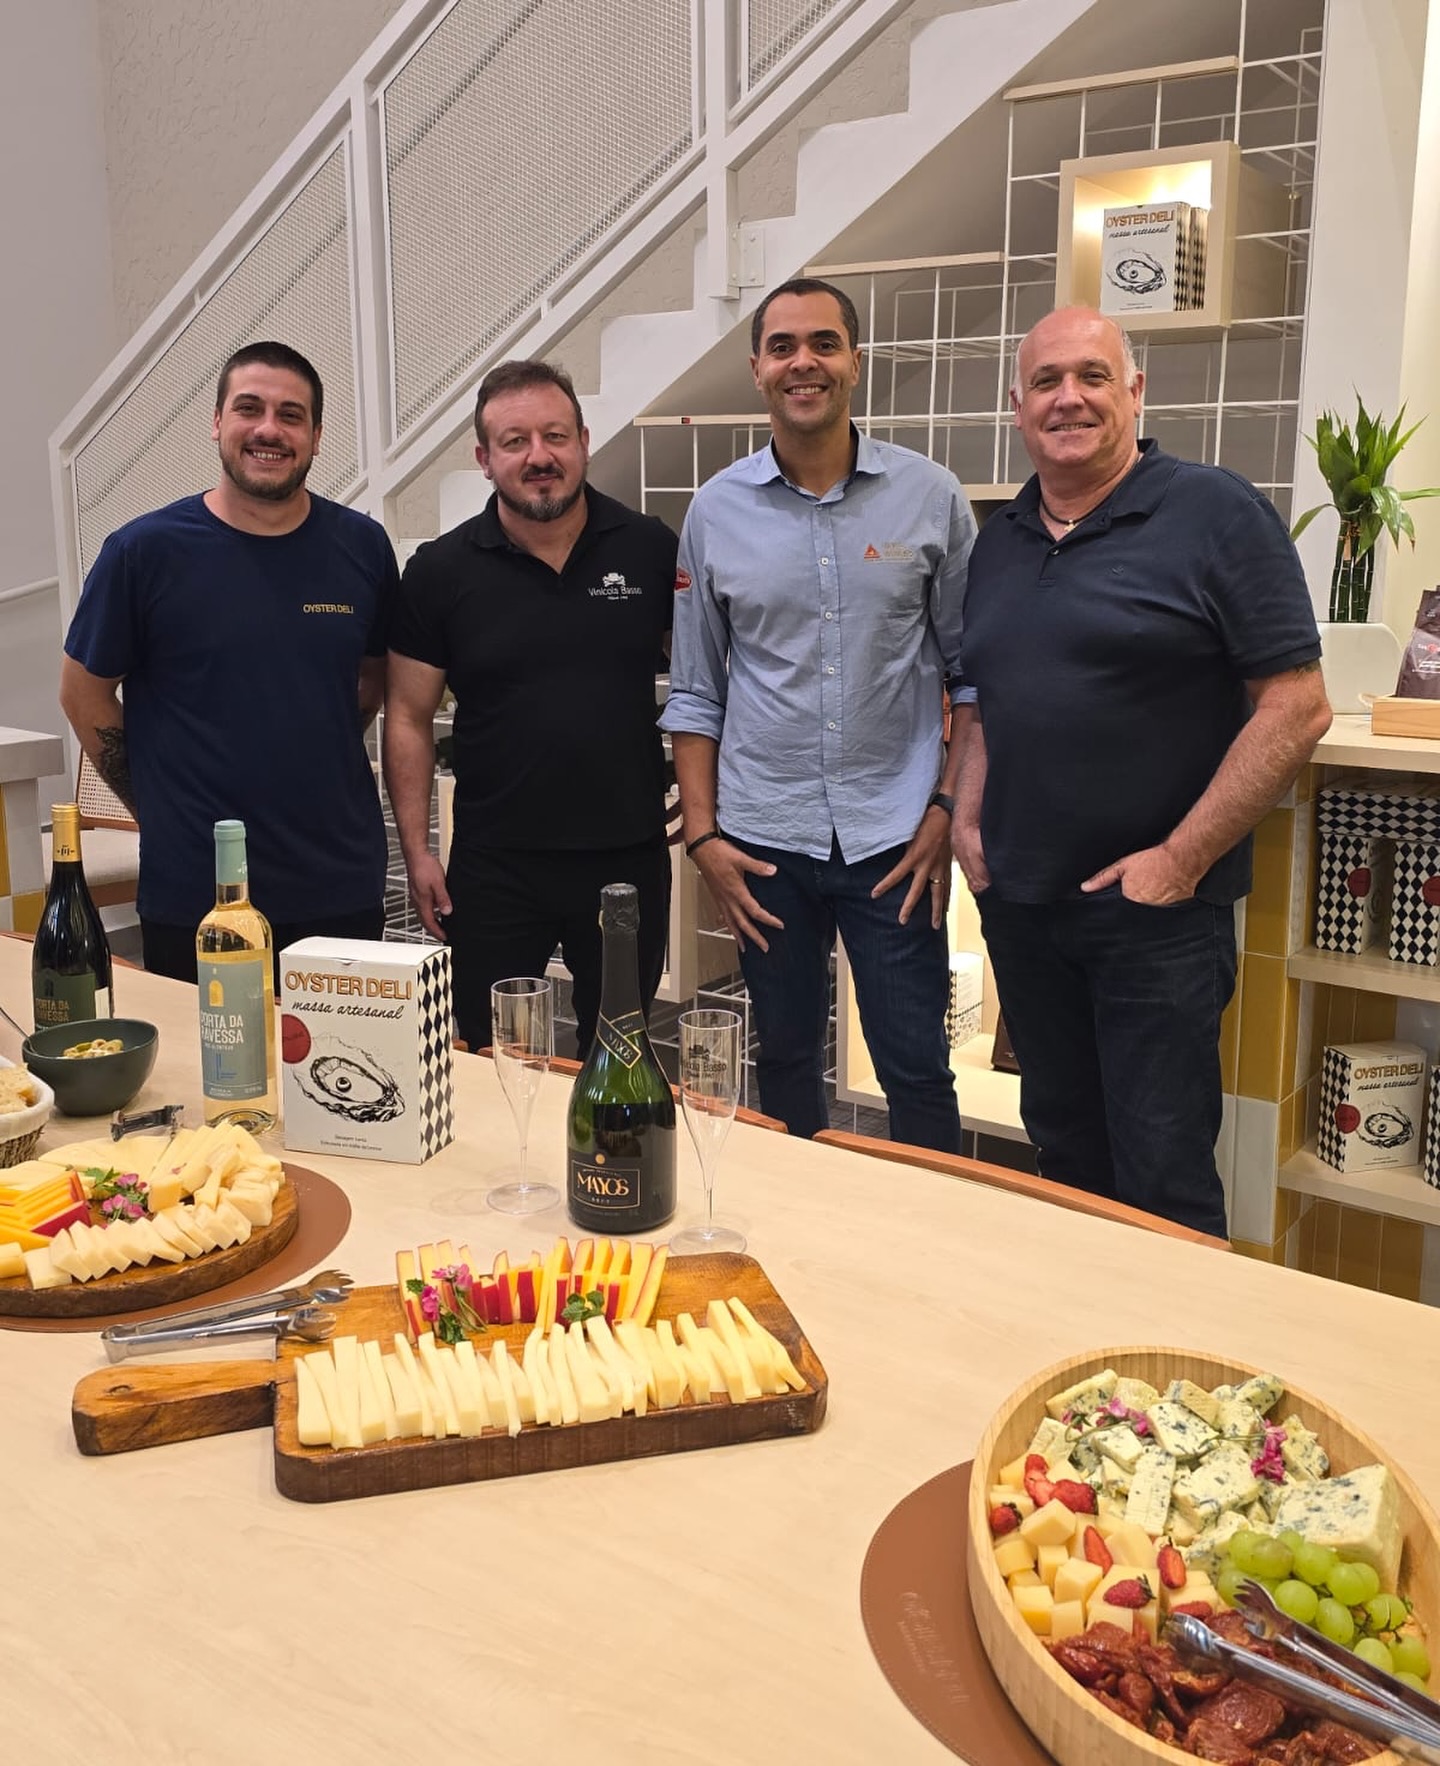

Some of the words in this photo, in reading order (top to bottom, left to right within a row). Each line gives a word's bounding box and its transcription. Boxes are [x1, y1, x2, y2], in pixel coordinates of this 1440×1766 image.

[1106, 212, 1148, 228] OYSTER
[1149, 210, 1174, 223] DELI
[303, 604, 337, 613] OYSTER
[337, 605, 354, 614] DELI
[285, 970, 363, 997] OYSTER
[366, 977, 411, 1000] DELI
[292, 1001, 334, 1014] massa
[337, 1005, 404, 1020] artesanal
[229, 1015, 244, 1028] DA
[1354, 1065, 1399, 1080] OYSTER
[1400, 1062, 1424, 1076] DELI
[577, 1172, 629, 1196] MAYOS
